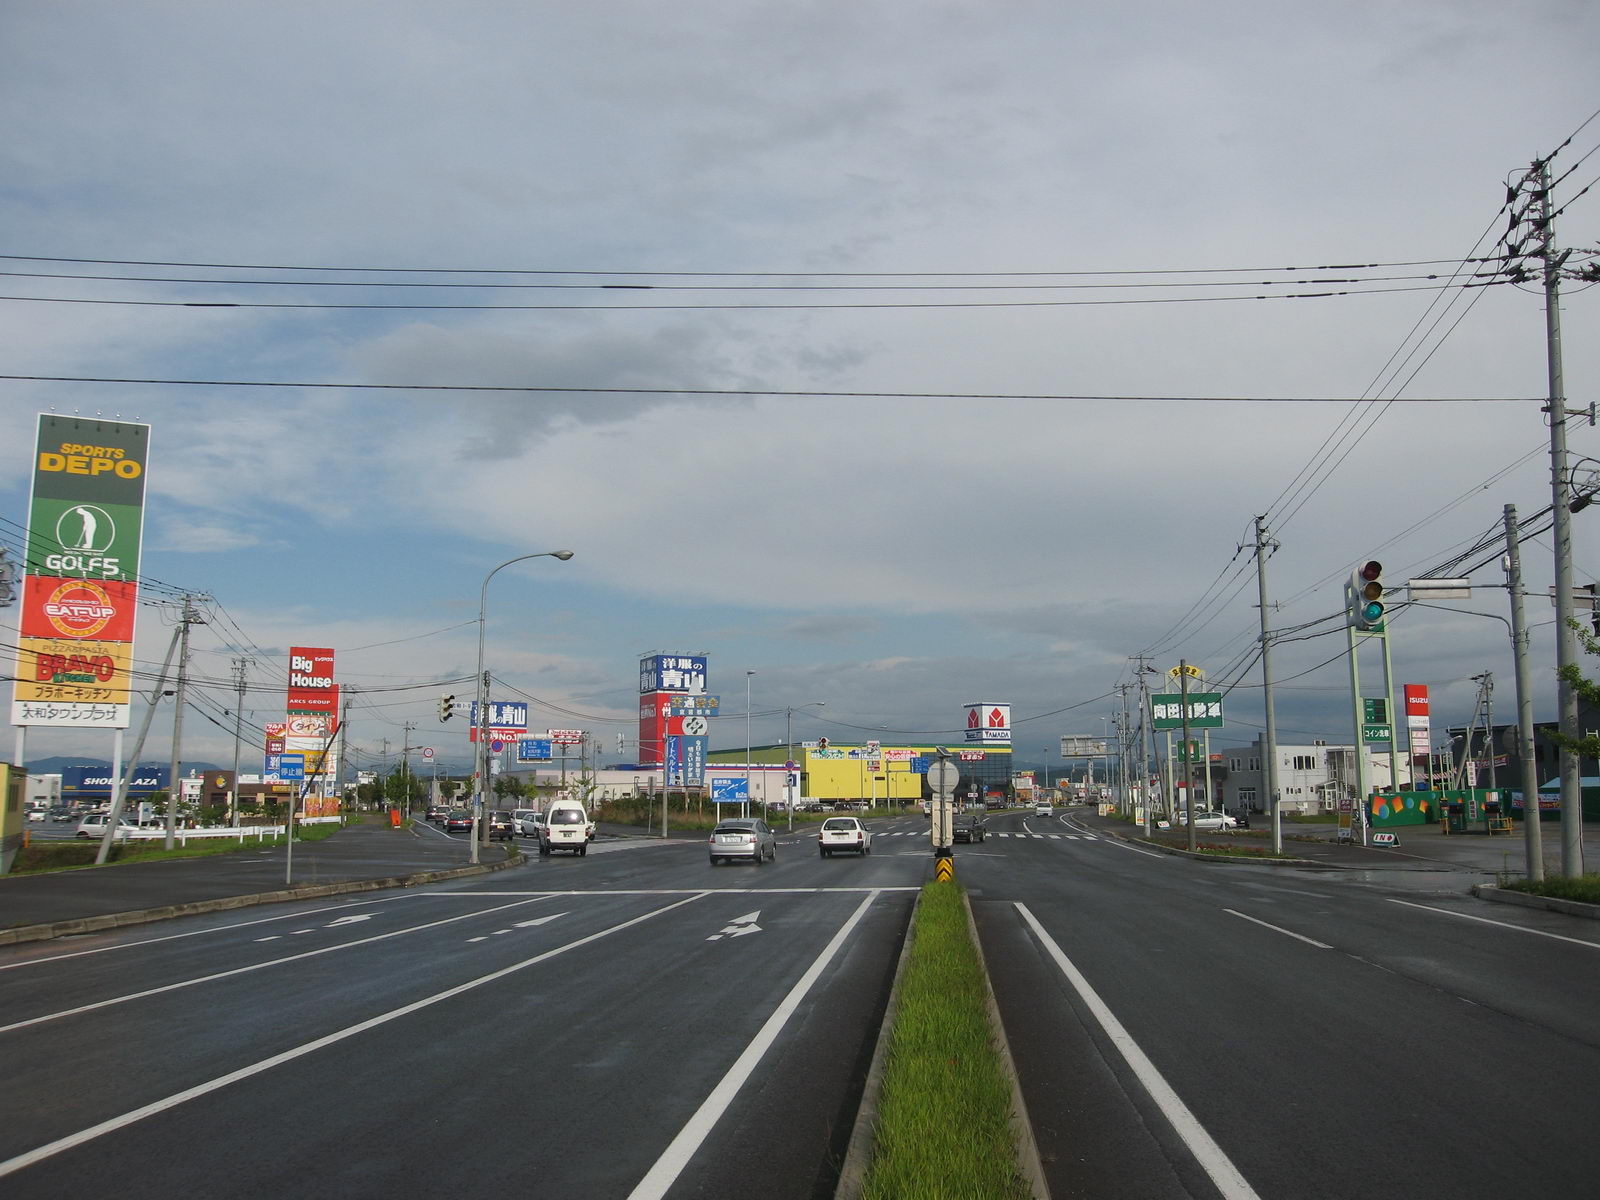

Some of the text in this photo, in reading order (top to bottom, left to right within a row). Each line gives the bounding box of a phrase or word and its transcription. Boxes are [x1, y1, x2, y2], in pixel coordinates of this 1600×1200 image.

[60, 443, 125, 459] SPORTS
[39, 452, 141, 479] DEPO
[46, 555, 119, 575] GOLF5
[36, 654, 114, 682] BRAVO
[291, 656, 313, 673] Big
[663, 658, 703, 670] 洋服の
[291, 673, 332, 688] House
[661, 669, 704, 688] 青山
[36, 686, 112, 700] ブラボーキッチン
[22, 708, 119, 722] 大和タウンプラザ
[120, 778, 158, 786] AZA
